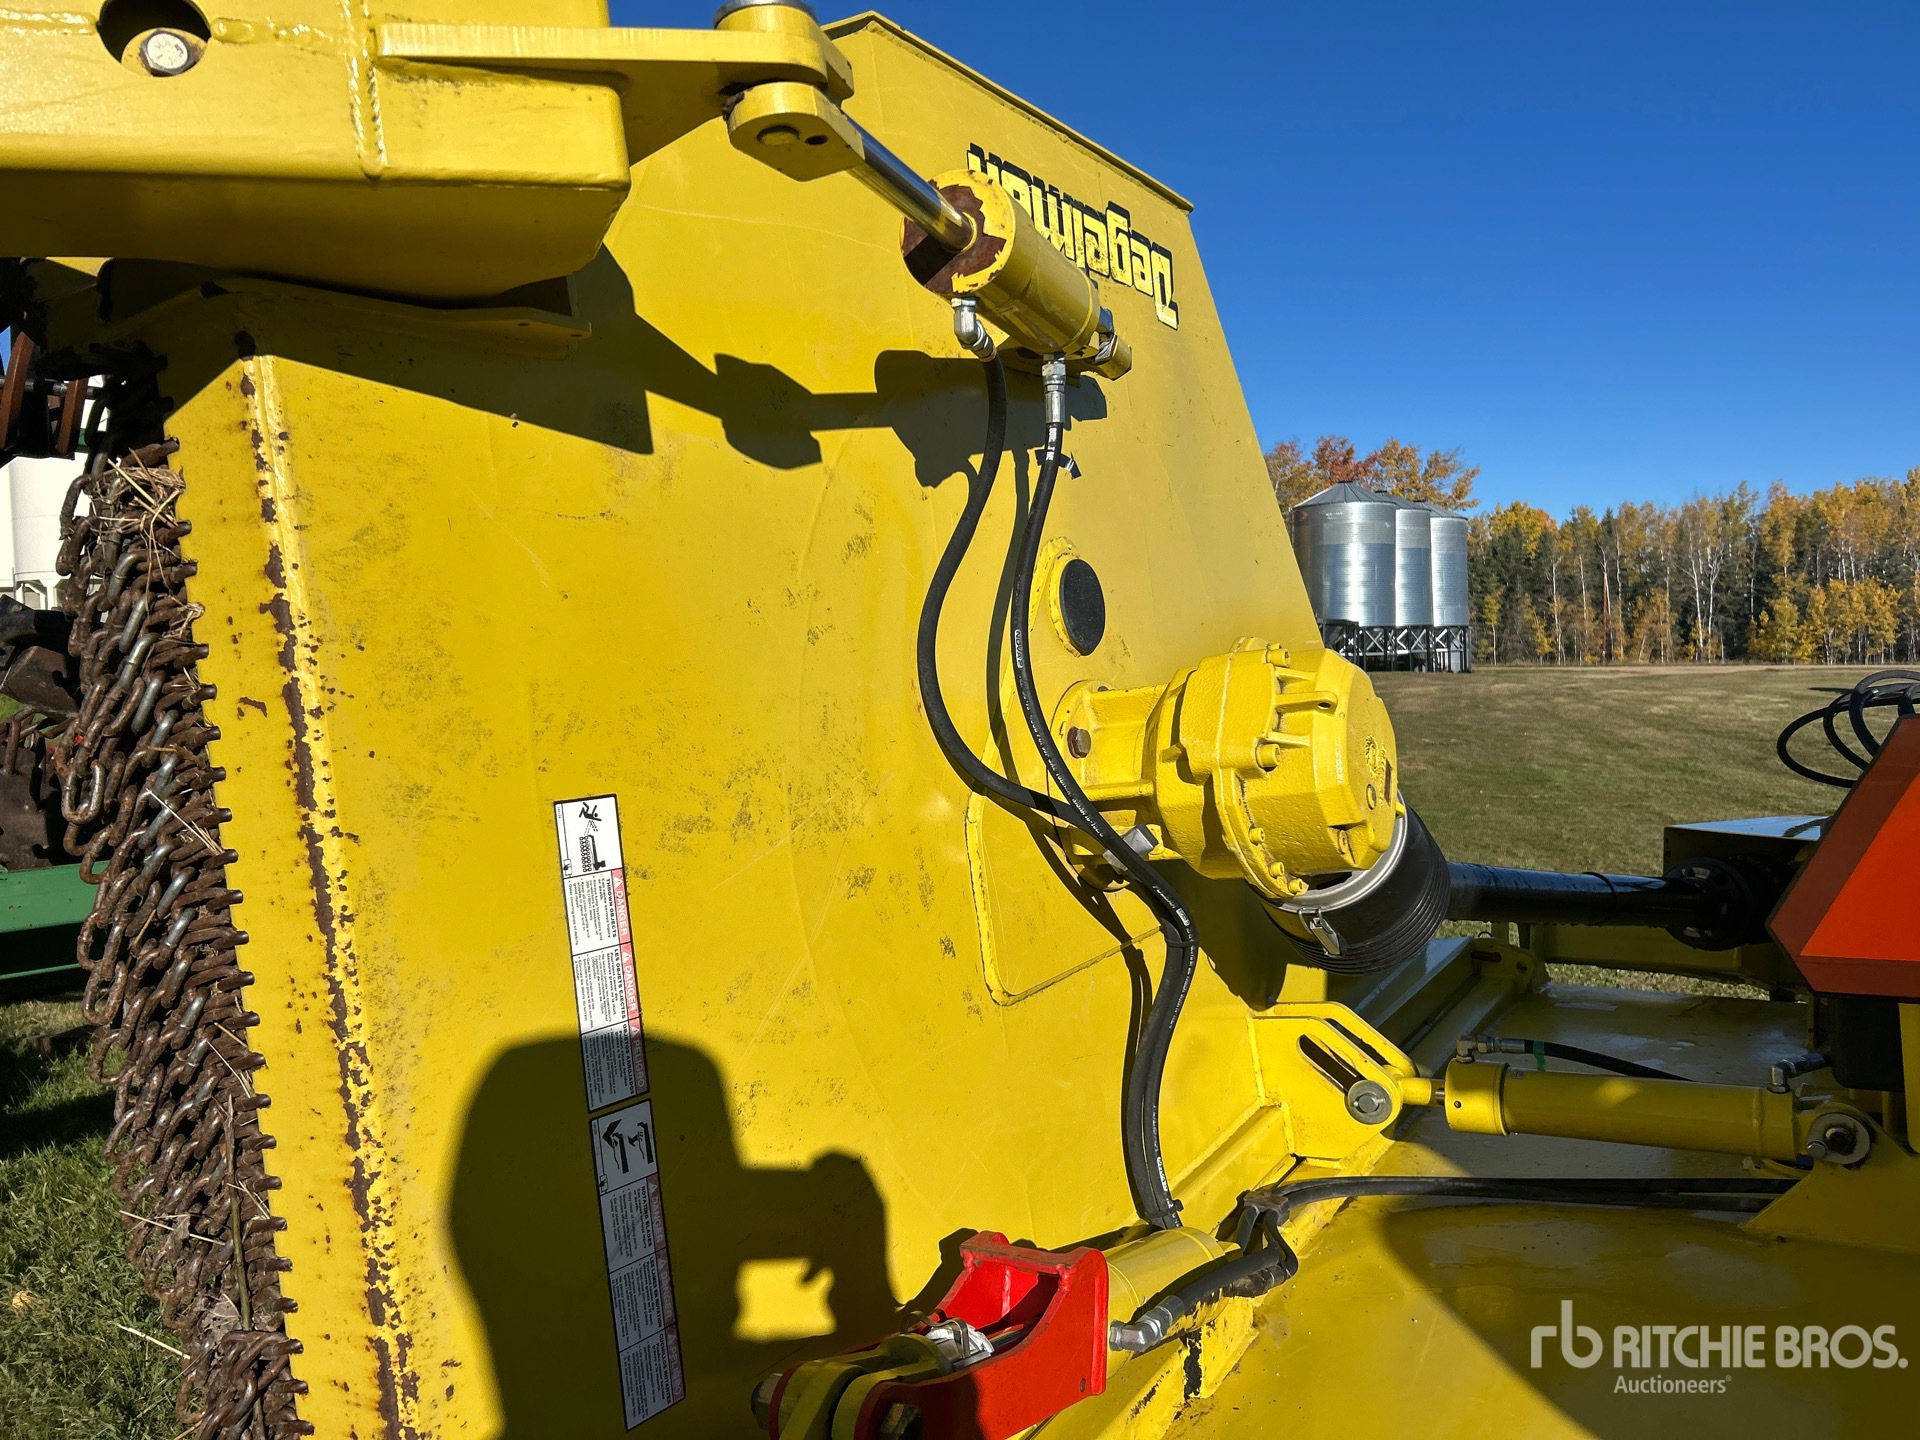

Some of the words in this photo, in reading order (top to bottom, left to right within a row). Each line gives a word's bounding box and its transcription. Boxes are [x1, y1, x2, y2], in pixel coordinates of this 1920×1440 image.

[615, 890, 628, 936] DANGER
[624, 964, 637, 1011] DANGER
[633, 1038, 644, 1088] PELIGRO
[651, 1195, 663, 1242] DANGER
[654, 1288, 658, 1297] EN
[660, 1271, 672, 1318] DANGER
[668, 1345, 681, 1396] PELIGRO
